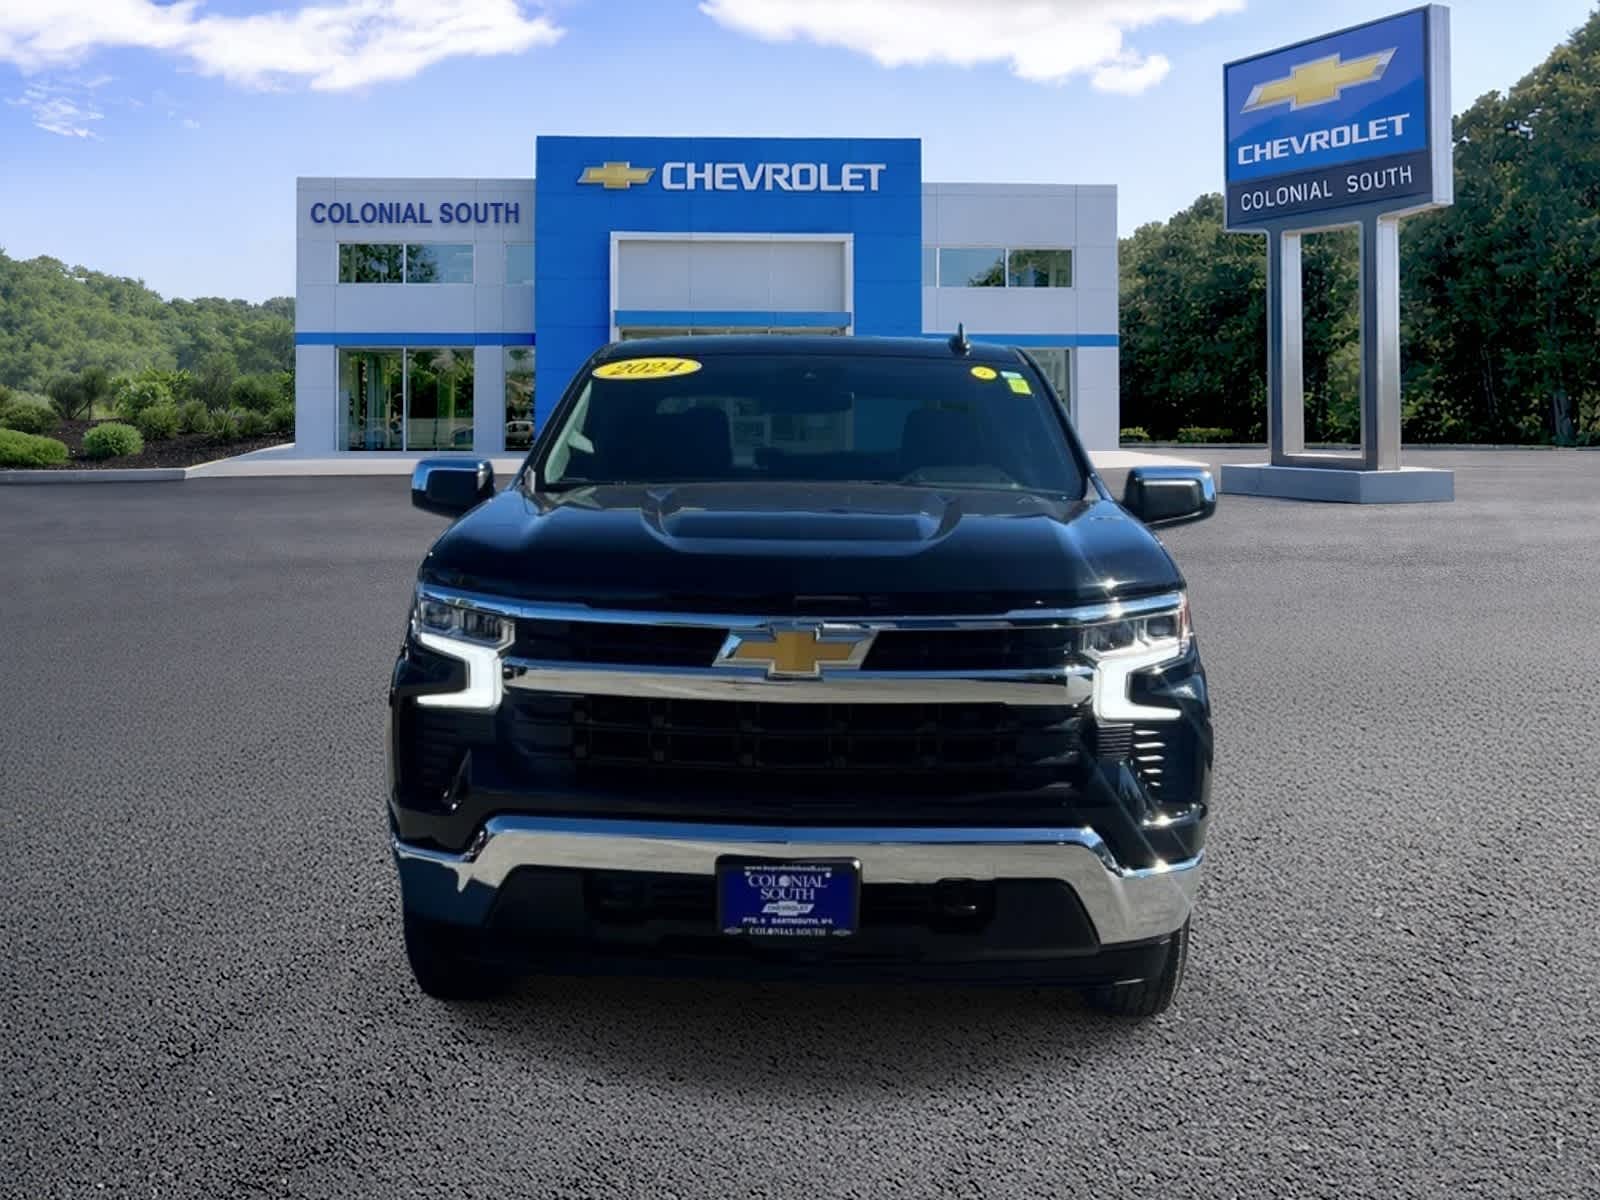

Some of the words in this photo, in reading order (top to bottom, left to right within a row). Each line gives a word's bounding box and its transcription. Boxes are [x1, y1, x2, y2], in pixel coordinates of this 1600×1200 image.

[1237, 113, 1410, 165] CHEVROLET
[661, 162, 887, 193] CHEVROLET
[1240, 179, 1333, 211] COLONIAL
[1346, 165, 1413, 194] SOUTH
[310, 202, 433, 225] COLONIAL
[439, 202, 521, 225] SOUTH
[747, 874, 827, 888] COLONIAL
[760, 888, 815, 900] SOUTH
[749, 927, 793, 936] COLONIAL
